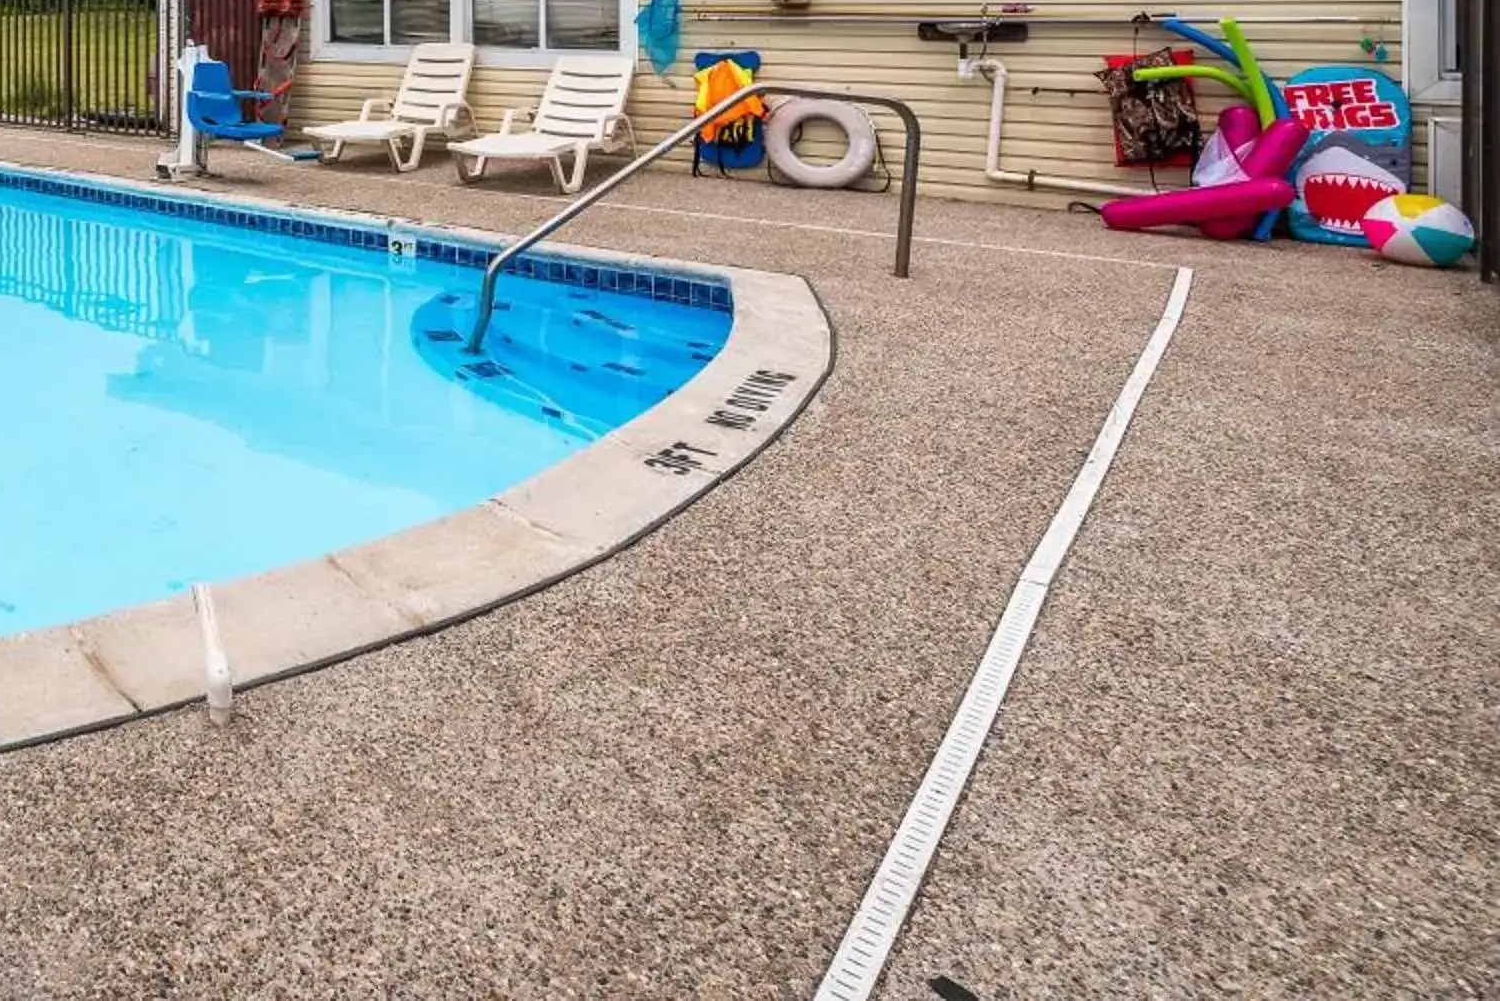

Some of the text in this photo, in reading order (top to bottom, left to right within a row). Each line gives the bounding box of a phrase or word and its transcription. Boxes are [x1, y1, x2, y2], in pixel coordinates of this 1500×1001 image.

[1284, 79, 1377, 108] FREE
[705, 370, 796, 432] NO DIVING
